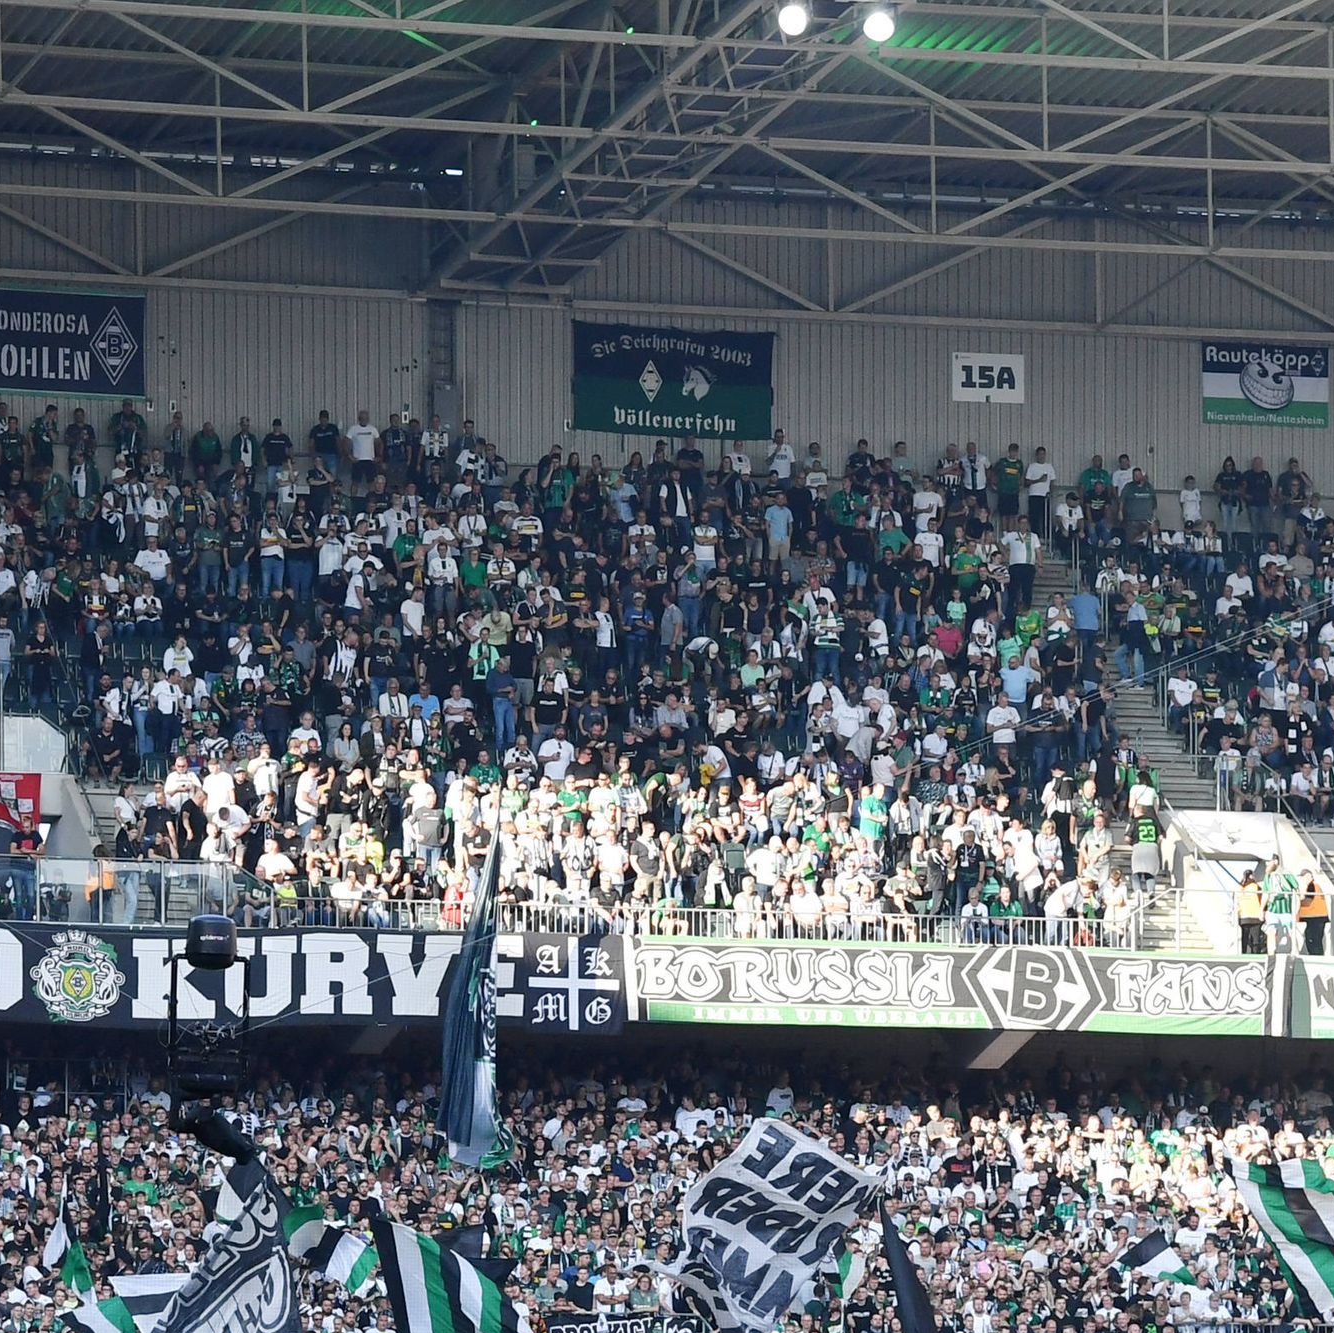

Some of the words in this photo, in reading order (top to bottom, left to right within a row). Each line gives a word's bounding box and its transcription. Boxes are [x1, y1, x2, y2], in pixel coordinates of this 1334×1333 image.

[590, 339, 617, 359] Die
[620, 334, 705, 358] Deichgrafen
[710, 345, 753, 367] 2003
[961, 365, 1016, 390] 15A
[1138, 825, 1156, 843] 23
[131, 933, 525, 1019] KURVE
[635, 949, 955, 1006] BORUSSIA
[1107, 960, 1270, 1014] FANS
[693, 1007, 782, 1021] IMMER
